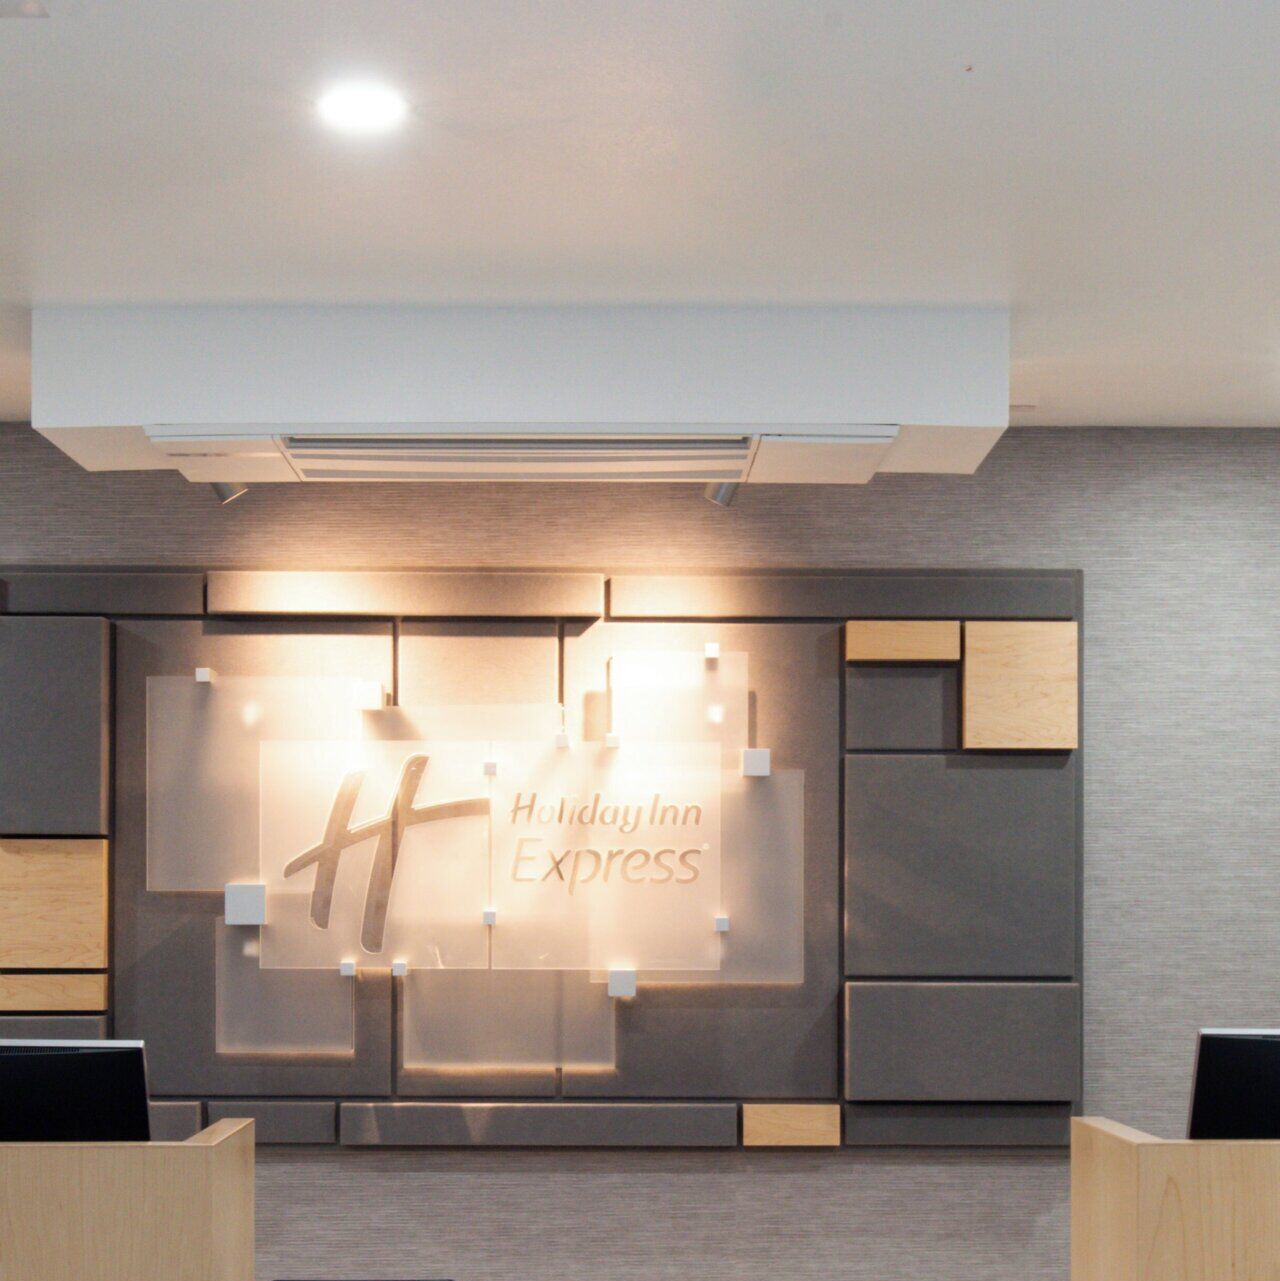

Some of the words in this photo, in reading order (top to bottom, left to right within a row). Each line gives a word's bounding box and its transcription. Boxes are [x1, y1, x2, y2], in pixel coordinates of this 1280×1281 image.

[509, 791, 645, 835] Holiday
[648, 792, 703, 827] Inn
[510, 836, 704, 897] Express
